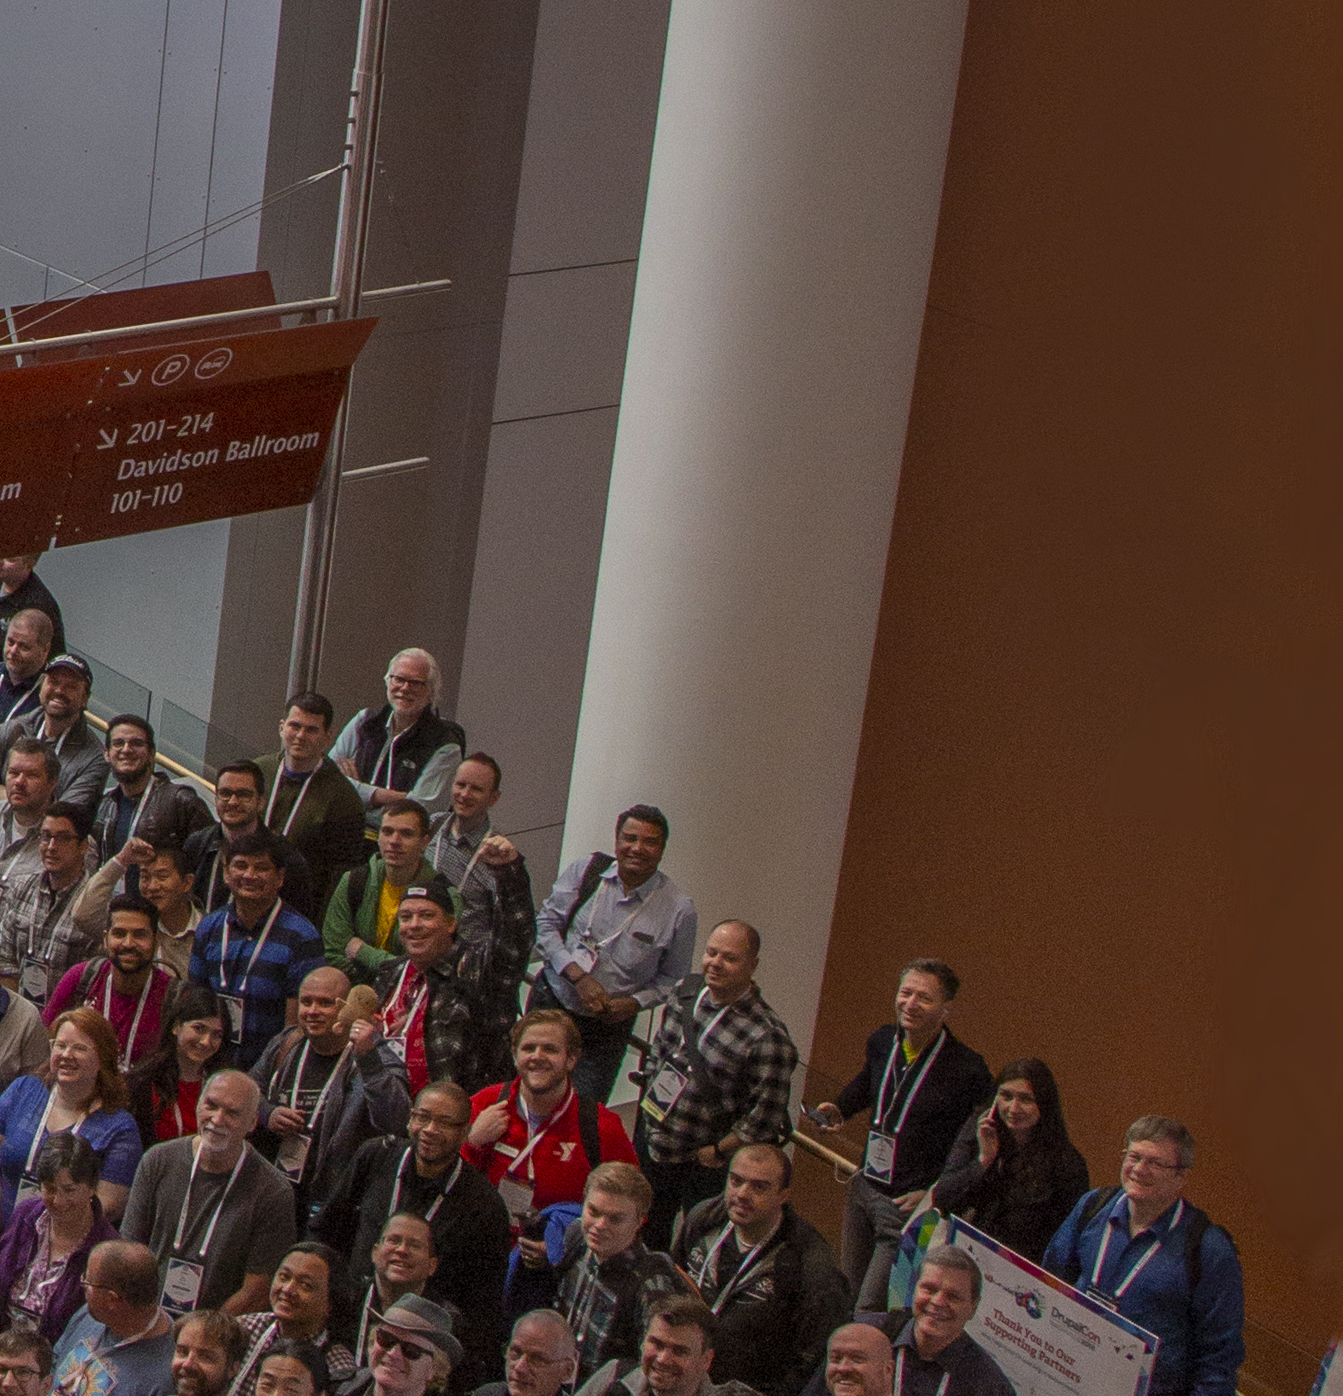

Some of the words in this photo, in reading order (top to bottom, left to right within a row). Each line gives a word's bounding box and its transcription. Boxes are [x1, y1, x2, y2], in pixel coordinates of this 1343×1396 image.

[126, 412, 214, 445] 201-214
[117, 449, 219, 480] Davidson
[225, 432, 320, 462] Ballroom
[110, 482, 183, 514] 101-110
[993, 1308, 1024, 1334] Thank
[1024, 1327, 1043, 1347] You
[1044, 1341, 1055, 1353] to
[1055, 1348, 1076, 1365] Our
[1051, 1306, 1101, 1345] DrupalCon
[984, 1316, 1037, 1359] Supporting
[1038, 1350, 1082, 1384] Partners
